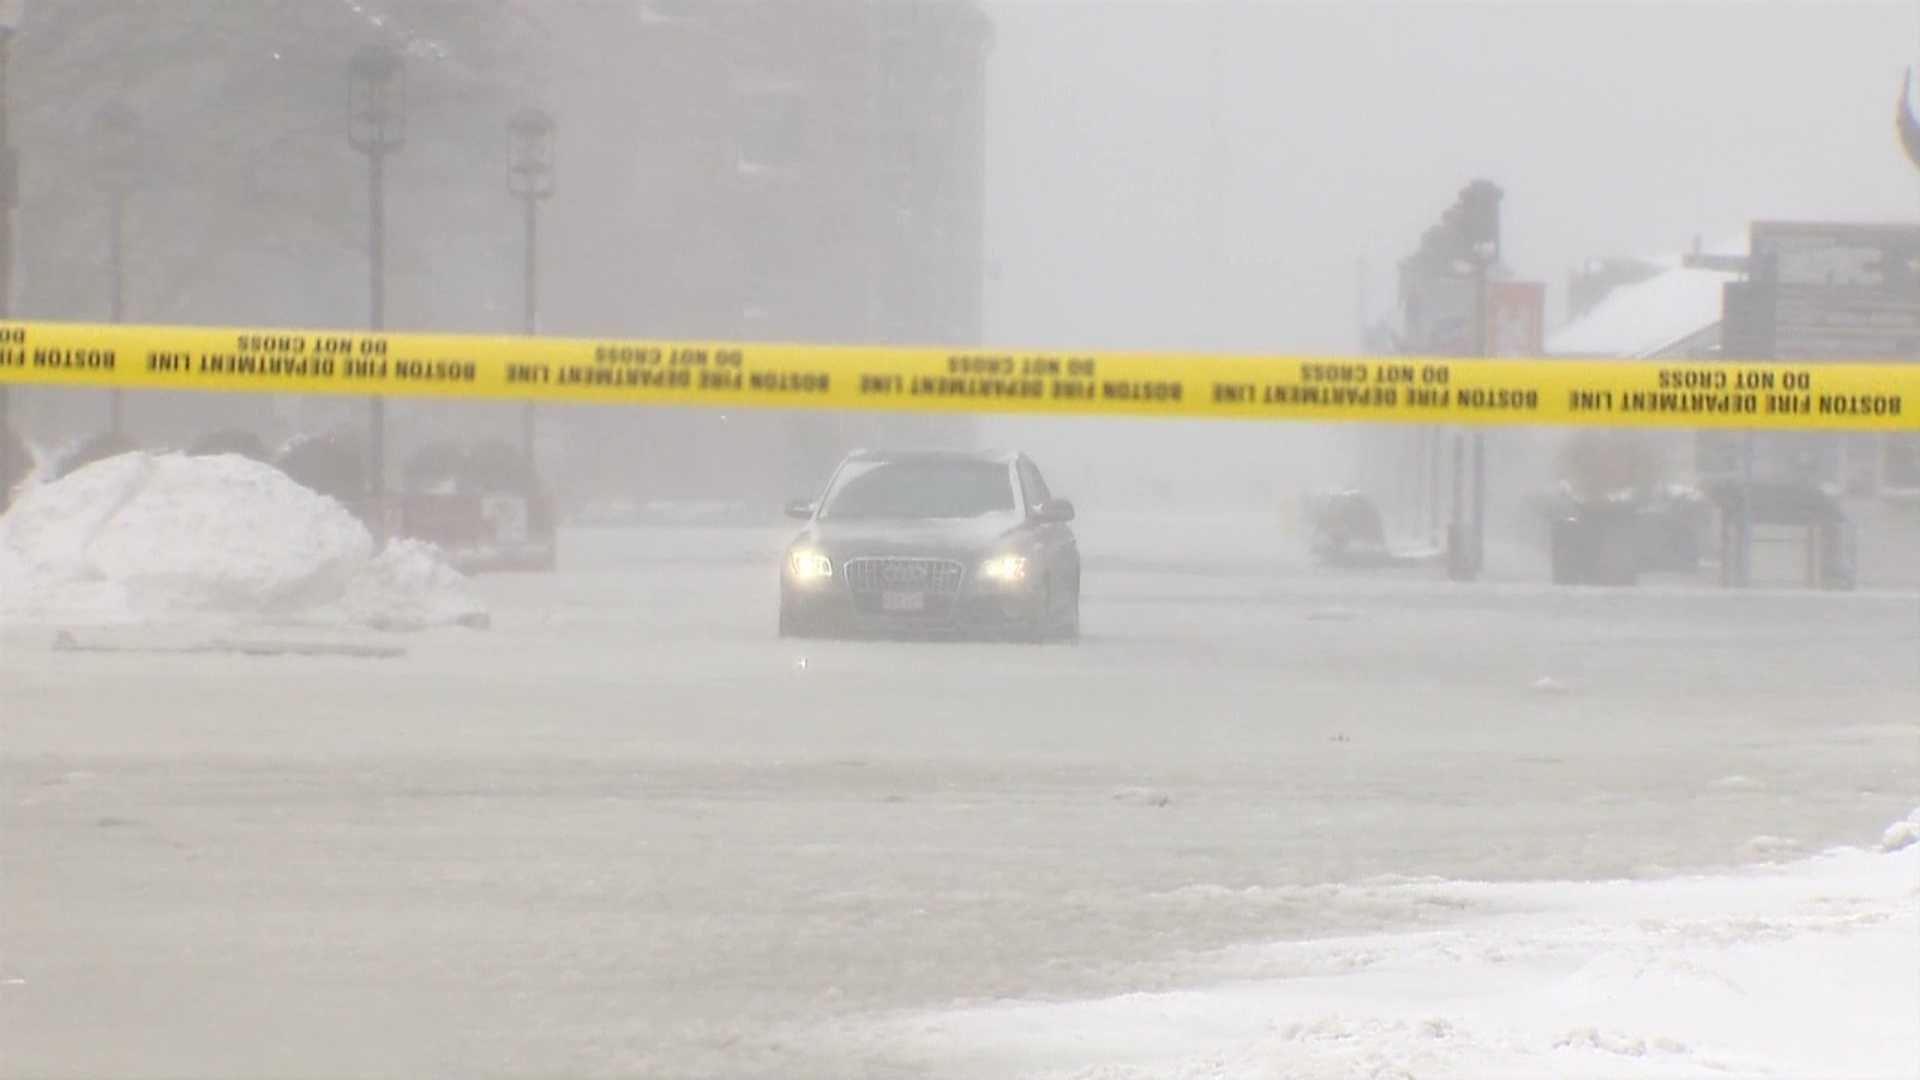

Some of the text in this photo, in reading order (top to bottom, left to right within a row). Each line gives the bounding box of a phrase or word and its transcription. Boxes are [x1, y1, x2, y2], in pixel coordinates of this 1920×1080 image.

[238, 337, 388, 355] DO NOT CROSS
[32, 349, 116, 370] BOSTON
[146, 354, 476, 381] BOSTON FIRE DEPARTMENT LINE
[595, 348, 742, 369] DO NOT CROSS
[506, 365, 830, 393] BOSTON FIRE DEPARTMENT LINE
[1301, 364, 1449, 385] DO NOT CROSS
[1658, 371, 1811, 390] DO NOT CROSS
[860, 375, 1183, 403] BOSTON FIRE DEPARTMENT LINE
[1213, 384, 1539, 410] BOSTON FIRE DEPARTMENT LINE
[1569, 391, 1902, 416] BOSTON FIRE DEPARTMENT LINE
